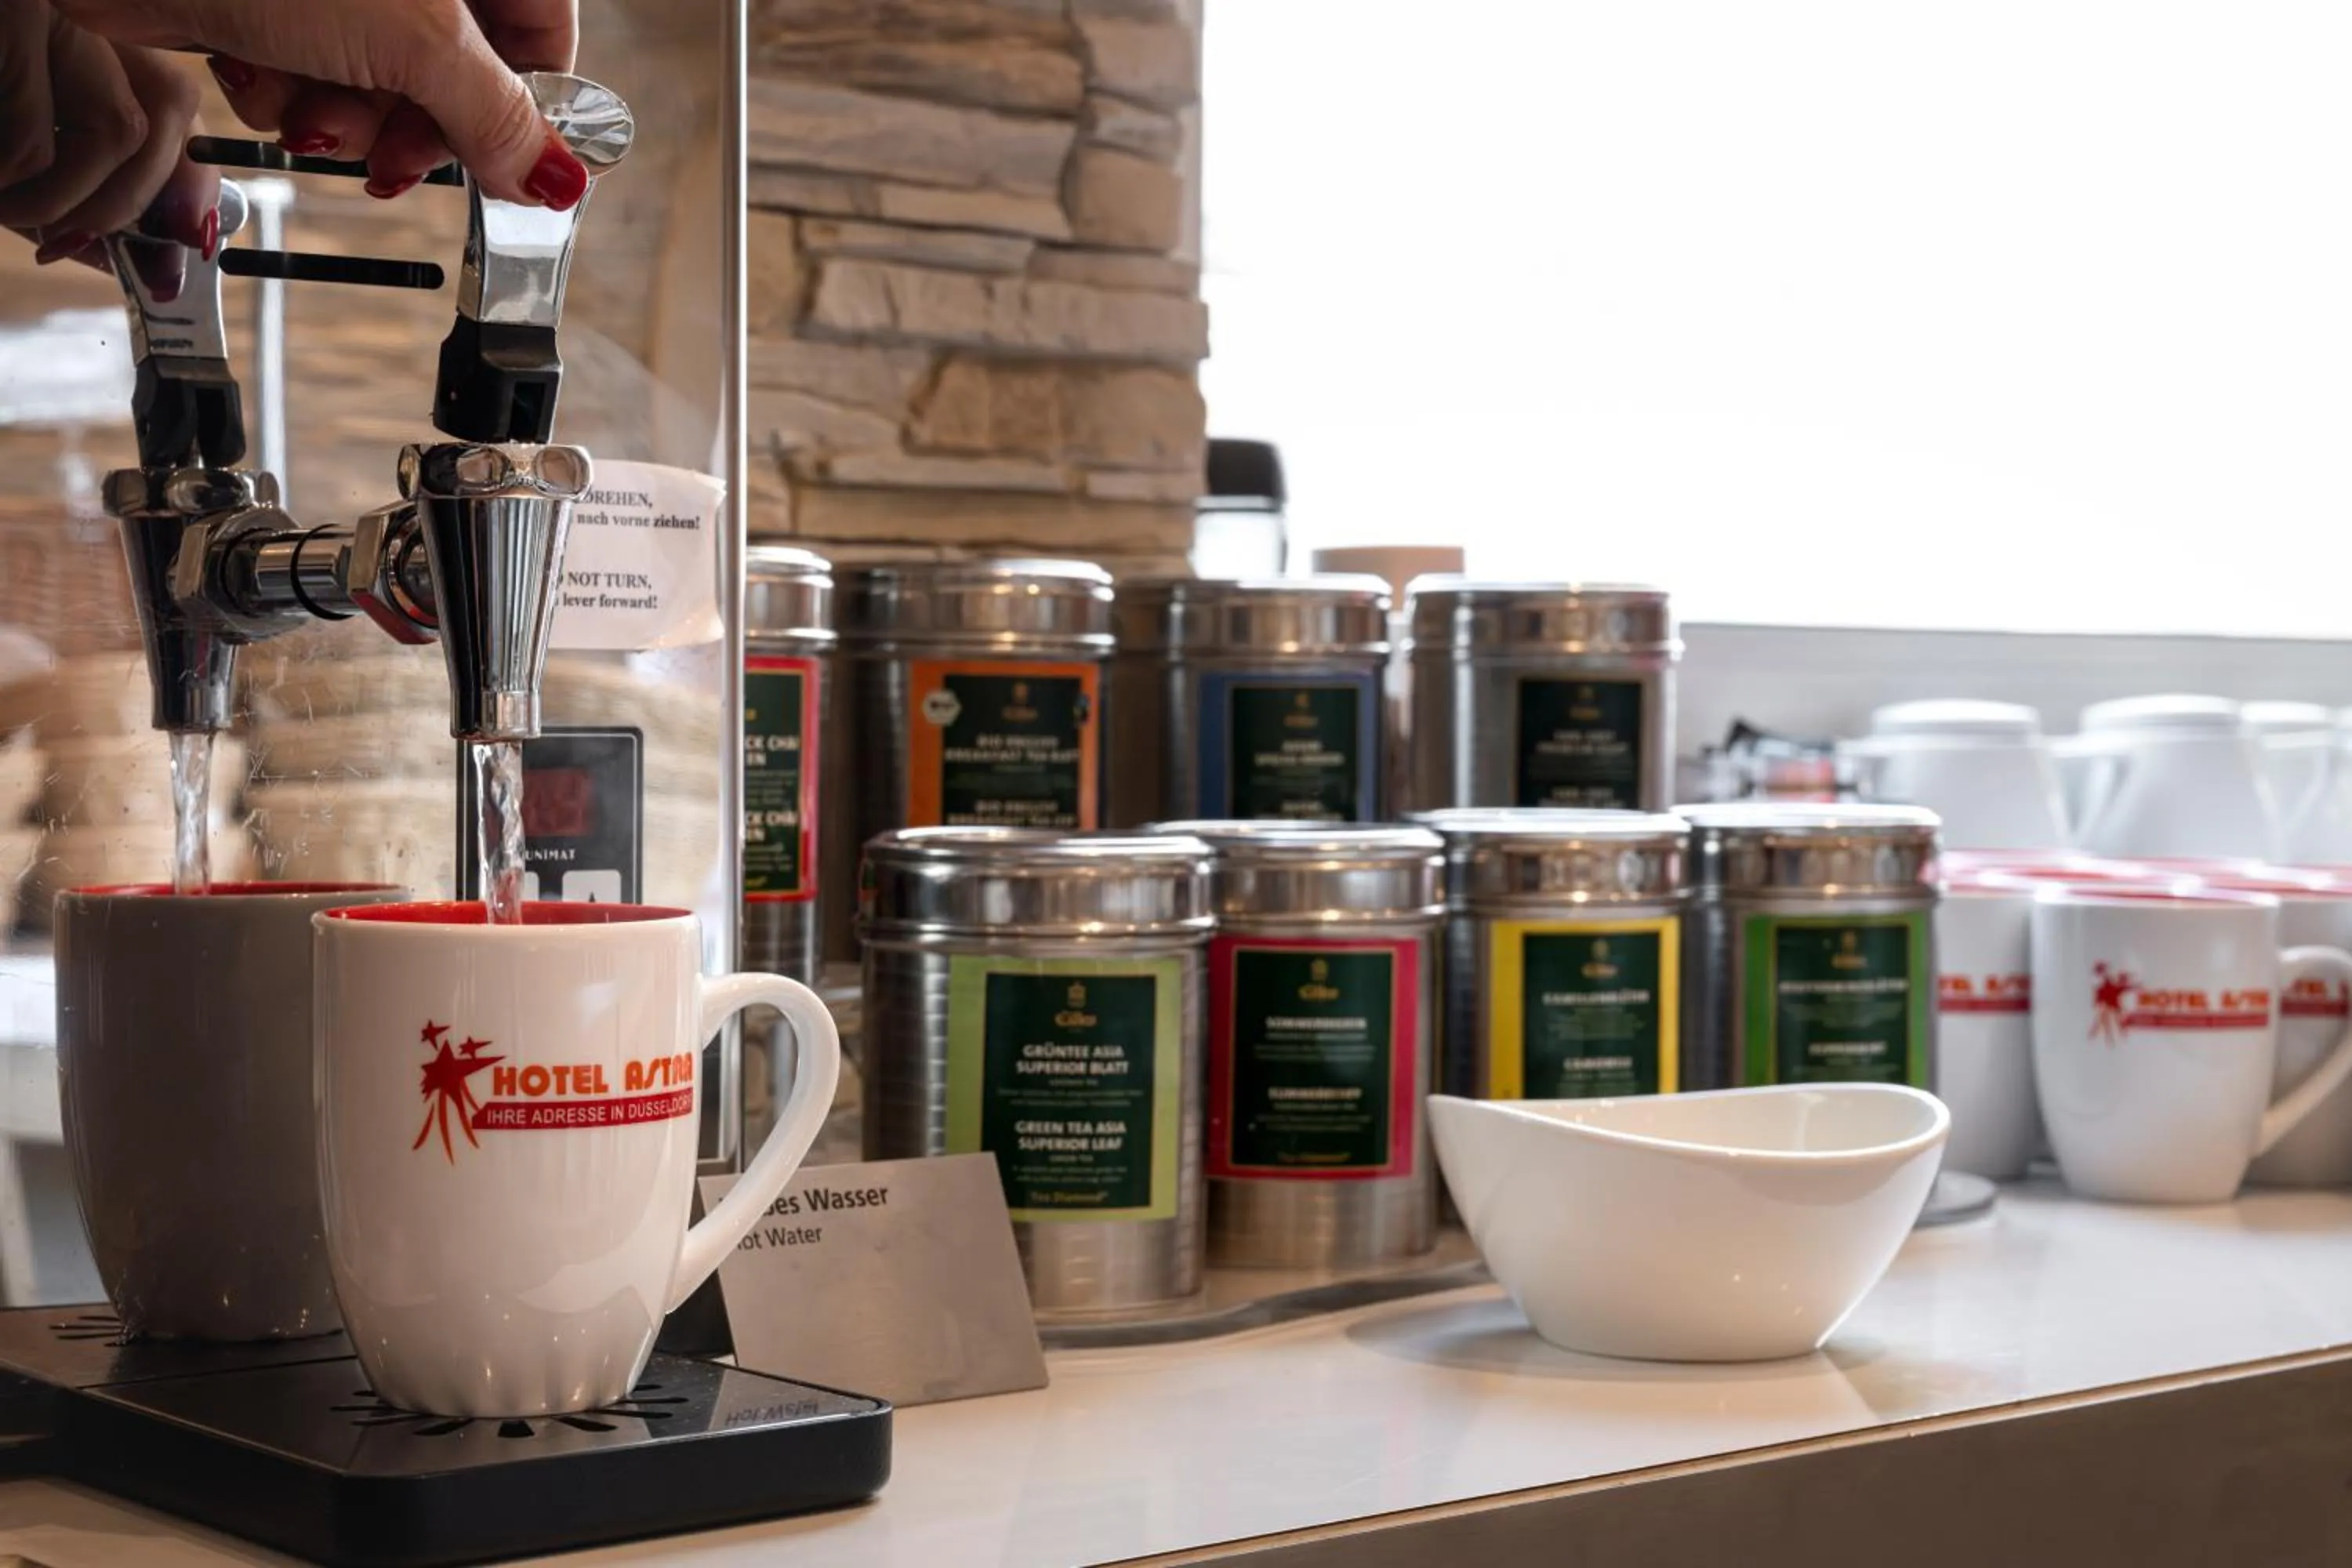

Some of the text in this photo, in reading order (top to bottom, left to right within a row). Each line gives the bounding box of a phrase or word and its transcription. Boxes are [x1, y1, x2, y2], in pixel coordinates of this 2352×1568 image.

[577, 511, 701, 530] nach vorne ziehen!
[568, 572, 601, 586] NOT
[604, 572, 652, 589] TURN,
[563, 592, 658, 609] lever forward!
[1022, 1042, 1124, 1058] GRÜNTEE ASIA
[1015, 1061, 1129, 1075] SUPERIOR BLATT
[493, 1064, 608, 1097] HOTEL
[487, 1109, 527, 1124] IHRE
[532, 1106, 606, 1124] ADRESSE
[611, 1103, 624, 1120] IN
[1015, 1120, 1127, 1134] GREEN TEA ASIA
[1018, 1138, 1123, 1151] SUPERIOR LEAF
[804, 1187, 888, 1212] Wasser
[764, 1226, 822, 1247] Water
